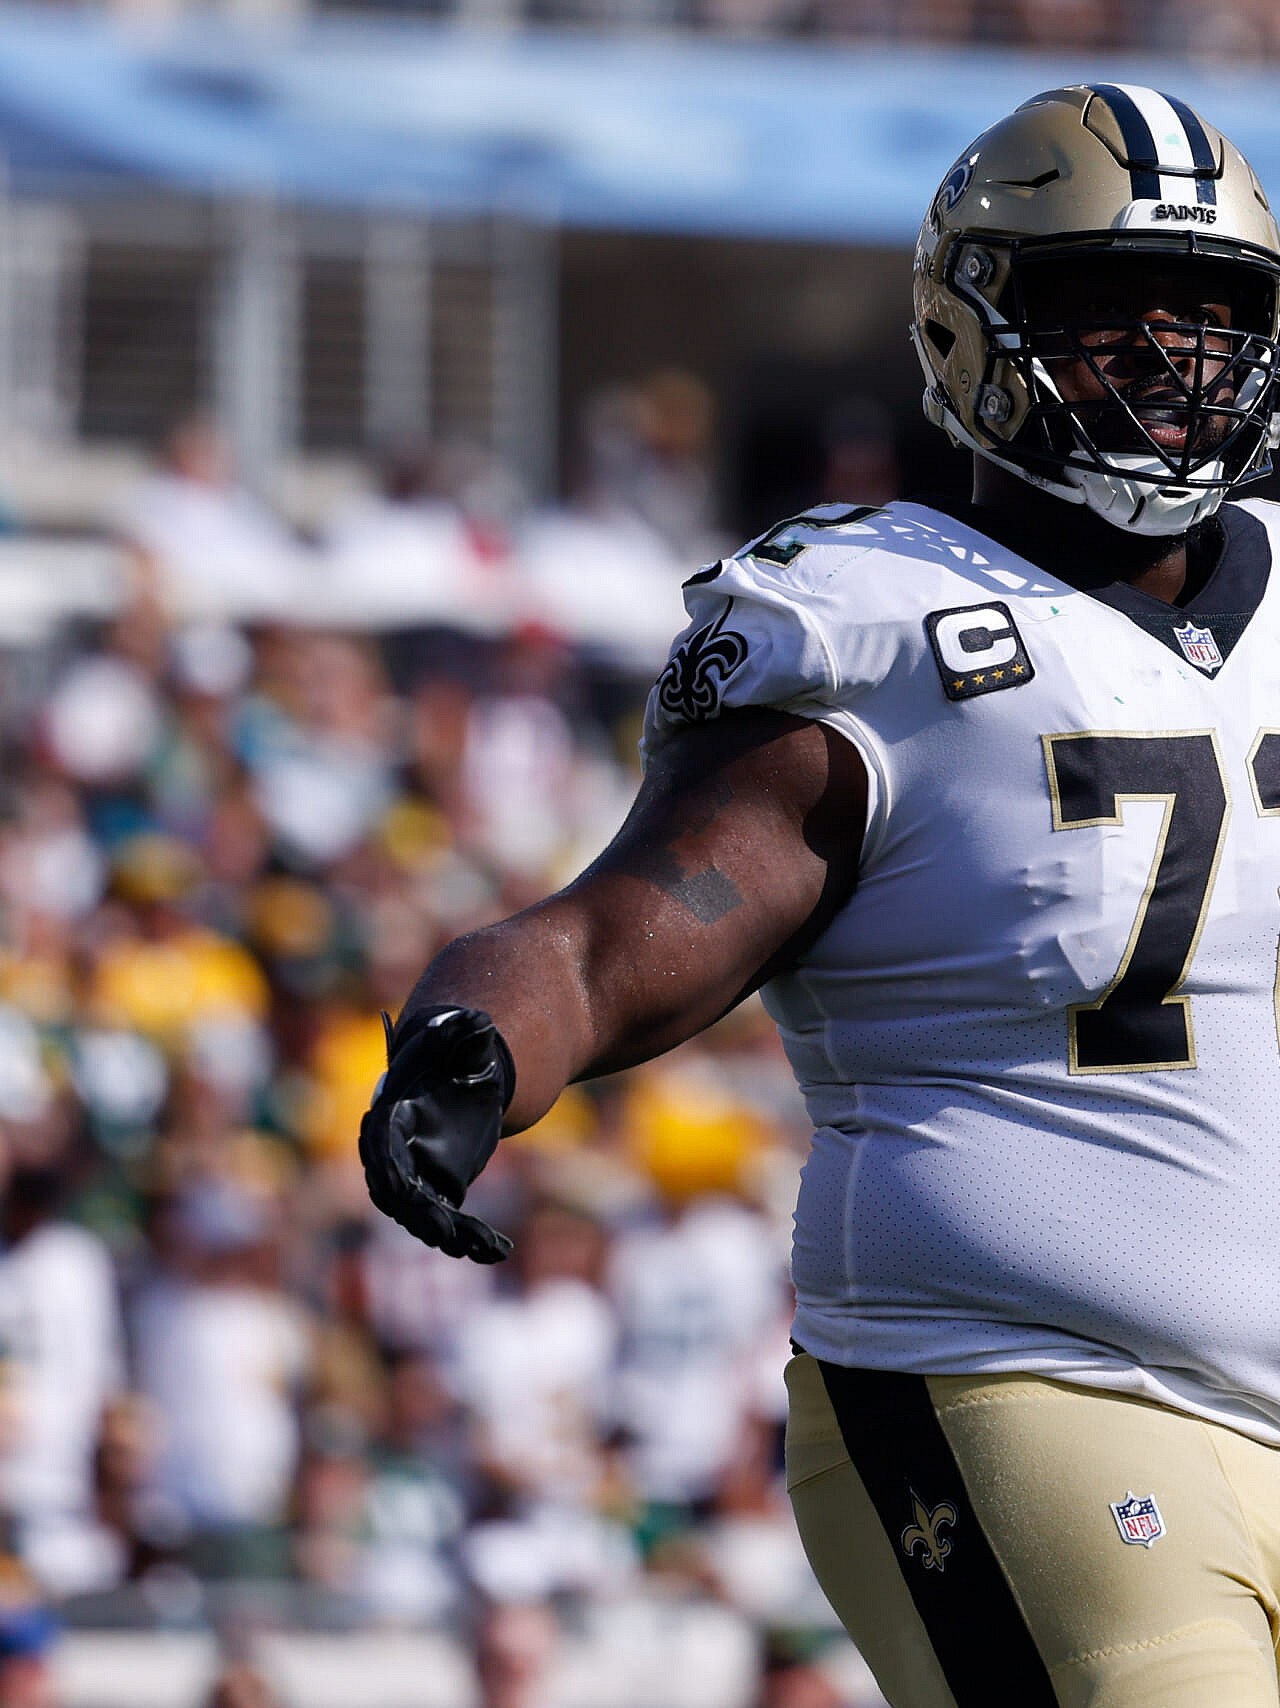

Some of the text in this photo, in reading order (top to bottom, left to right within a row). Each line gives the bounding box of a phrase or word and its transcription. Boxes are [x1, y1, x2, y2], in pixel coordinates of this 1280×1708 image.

[1154, 204, 1217, 224] SAINTS
[936, 608, 1018, 673] C
[1187, 644, 1217, 661] NFL
[1124, 1515, 1158, 1538] NFL
